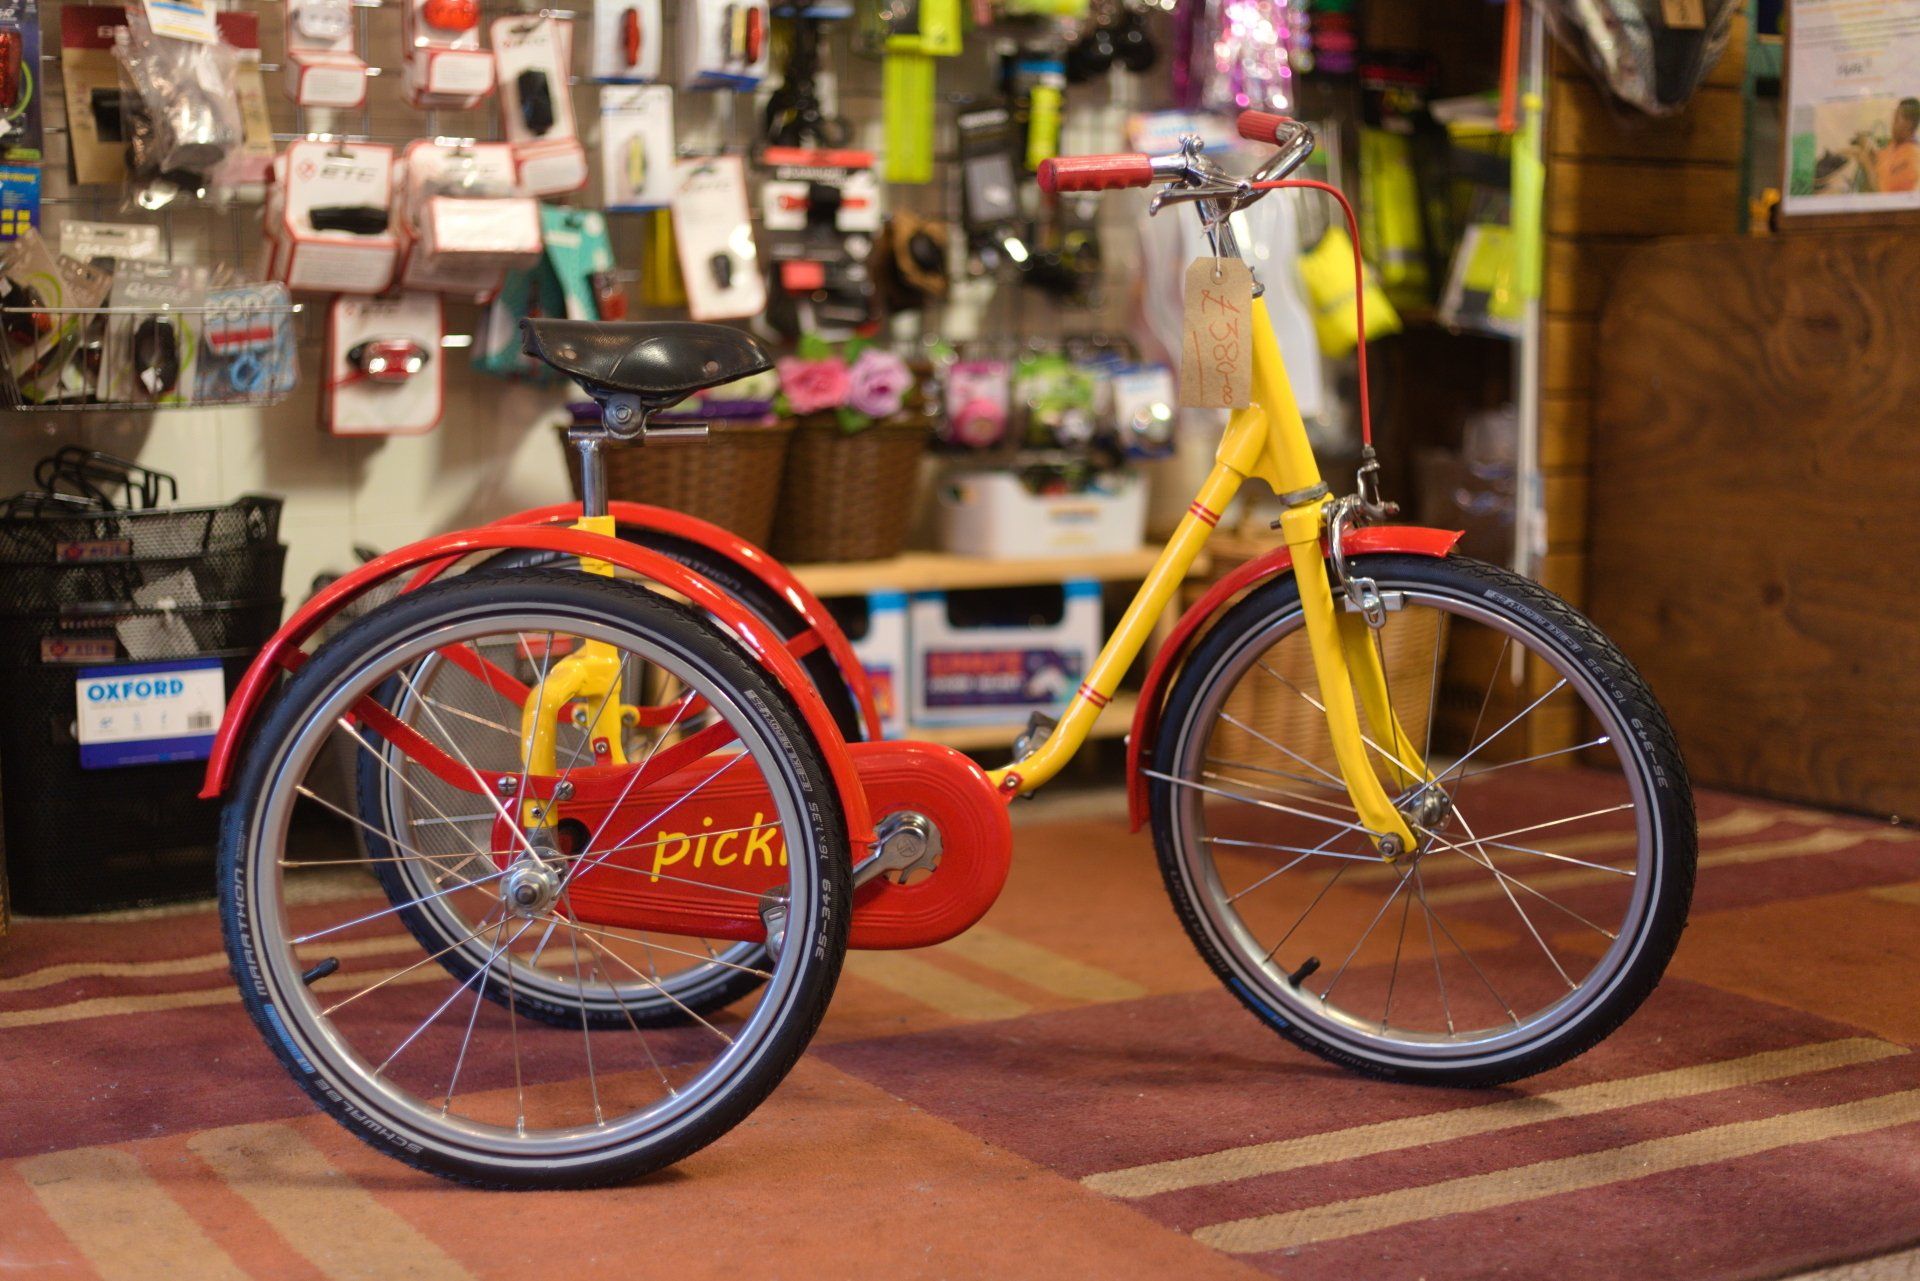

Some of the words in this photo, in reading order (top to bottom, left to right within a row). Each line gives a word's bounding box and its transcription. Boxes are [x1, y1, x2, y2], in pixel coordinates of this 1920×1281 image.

[87, 678, 184, 701] OXFORD
[1630, 717, 1669, 789] 35-349
[232, 867, 270, 997] MARATHON
[814, 878, 832, 961] 35-349
[314, 1077, 425, 1155] SCHWALBE
